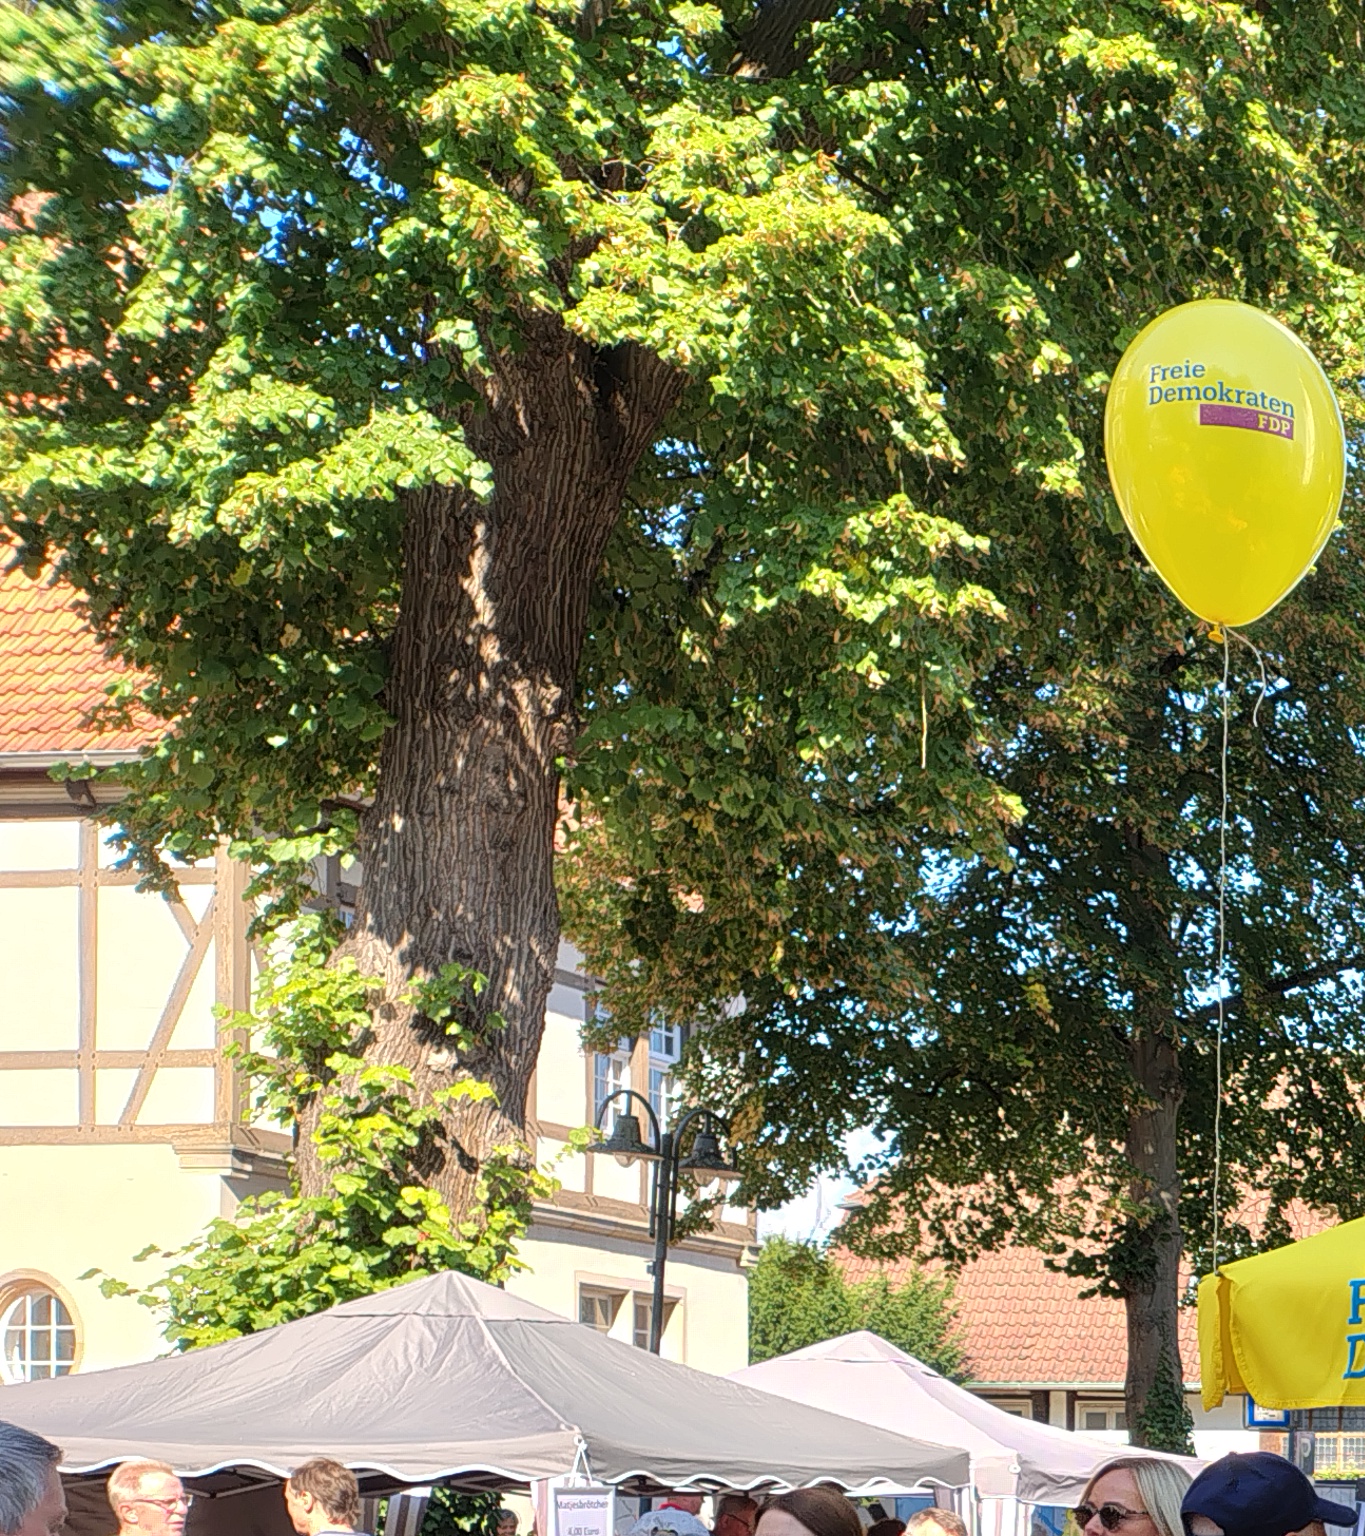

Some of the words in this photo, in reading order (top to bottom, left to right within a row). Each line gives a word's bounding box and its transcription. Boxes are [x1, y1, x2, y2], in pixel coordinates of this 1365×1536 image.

[1150, 360, 1206, 383] Freie
[1149, 381, 1295, 418] Demokraten
[1257, 413, 1292, 436] FDP
